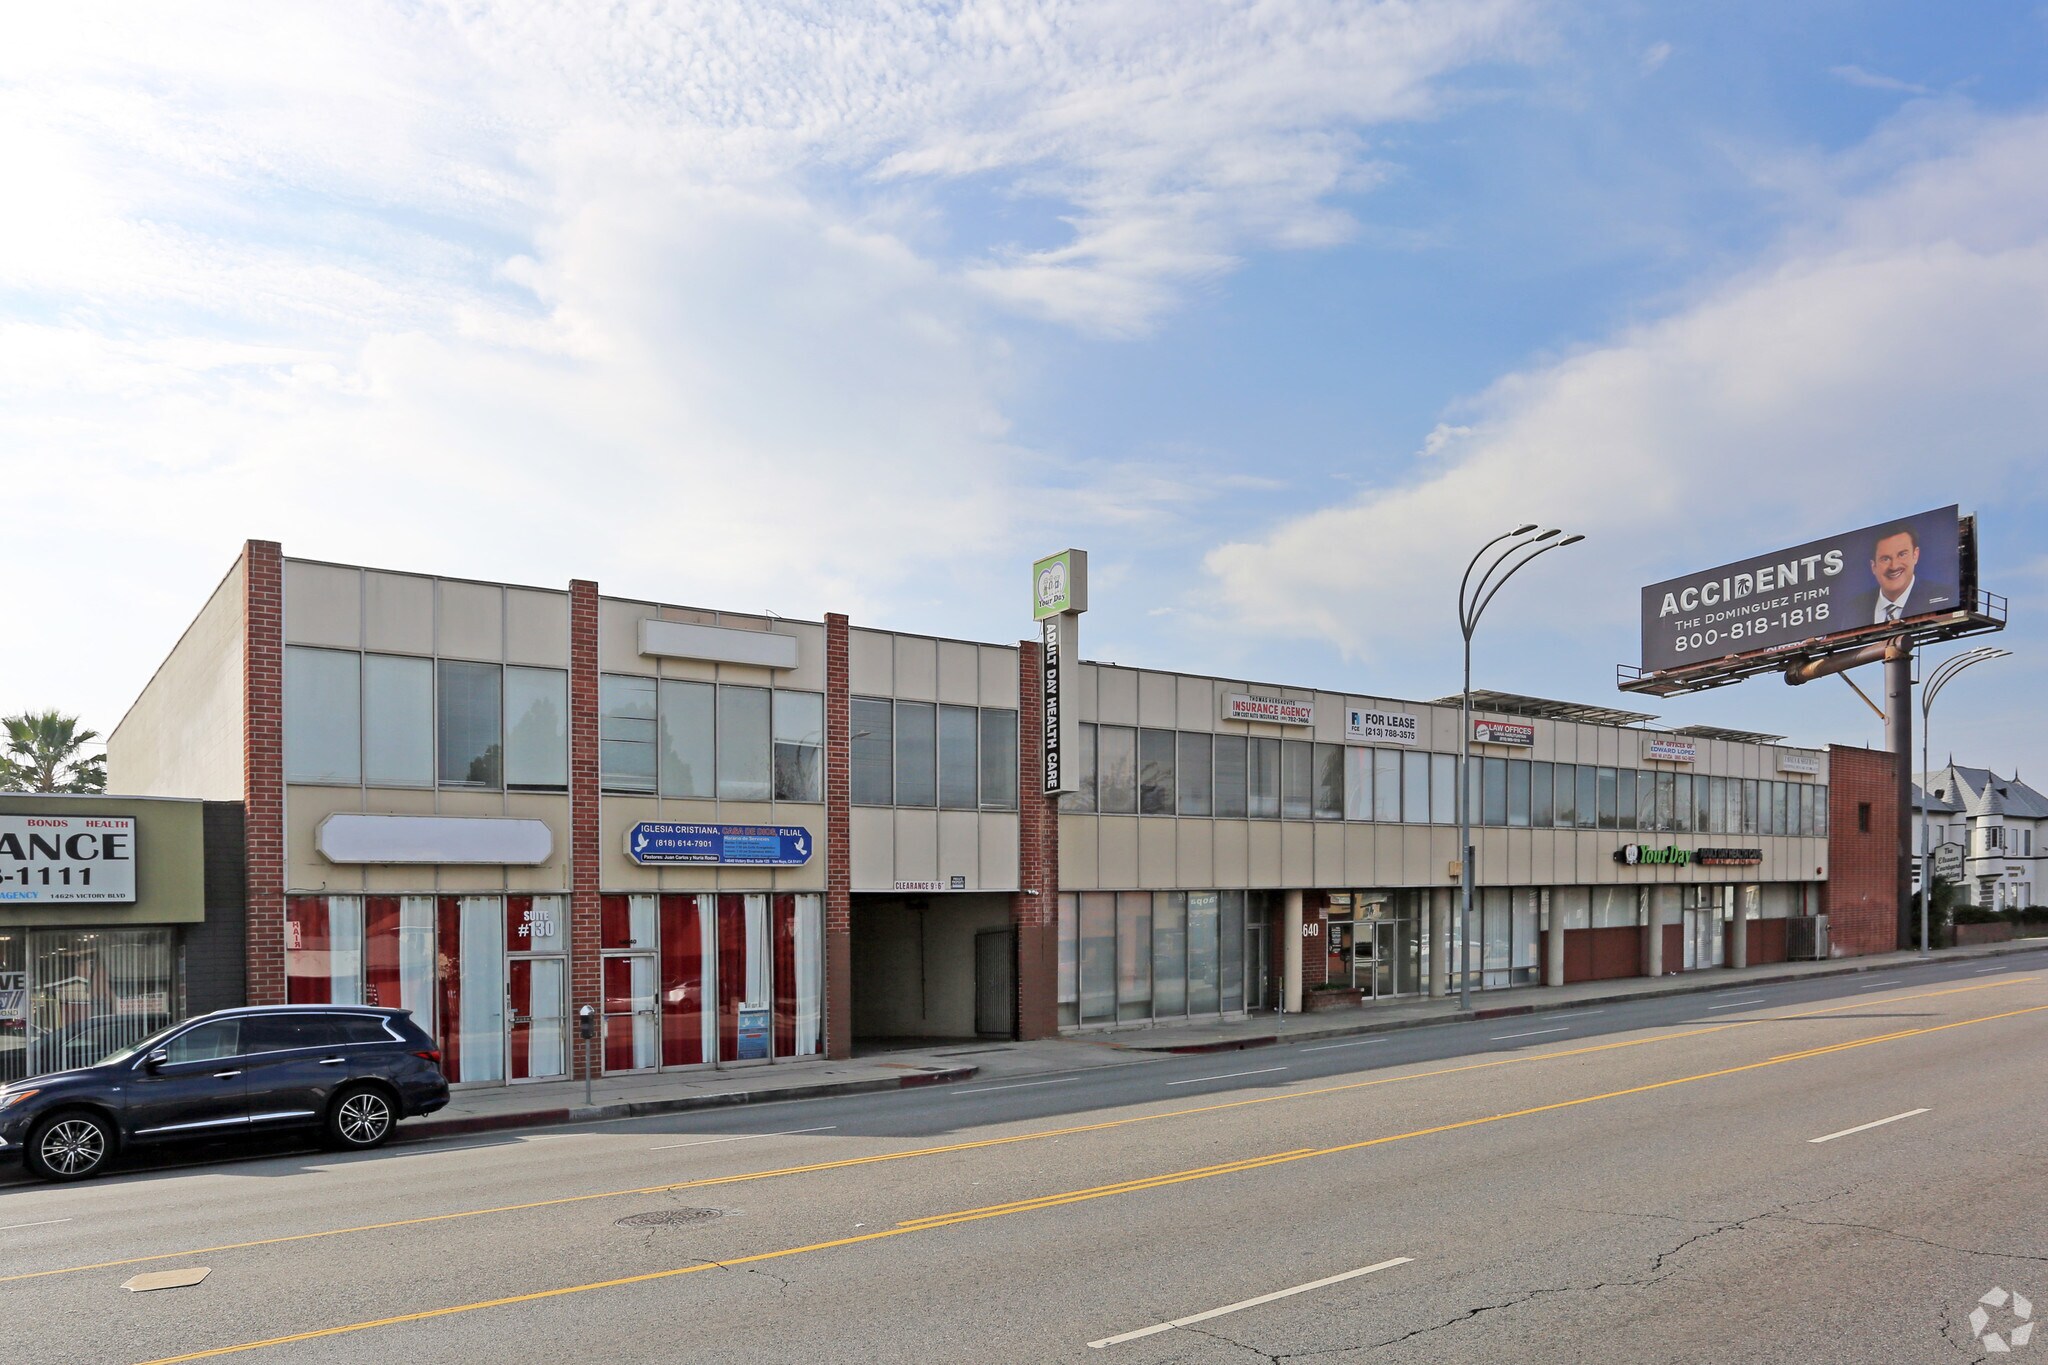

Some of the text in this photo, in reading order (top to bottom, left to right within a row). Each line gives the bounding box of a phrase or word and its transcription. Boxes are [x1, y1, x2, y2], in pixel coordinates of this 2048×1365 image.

[1659, 550, 1845, 618] ACCIDENTS
[1675, 586, 1830, 632] THE DOMINGUEZ FIRM
[1675, 603, 1830, 652] 800-818-1818
[1046, 624, 1058, 788] ADULT DAY HEALTH CARE
[1233, 701, 1311, 717] INSURANCE AGENCY
[1366, 714, 1415, 729] FOR LEASE
[1366, 727, 1382, 737] (213)
[1385, 729, 1415, 740] 788-3575
[1505, 726, 1531, 735] OFFICES
[676, 826, 720, 835] CRISTIANA,
[1640, 845, 1691, 867] Your Day
[524, 911, 549, 921] SUITE
[518, 920, 554, 937] #130
[1302, 923, 1318, 937] 640
